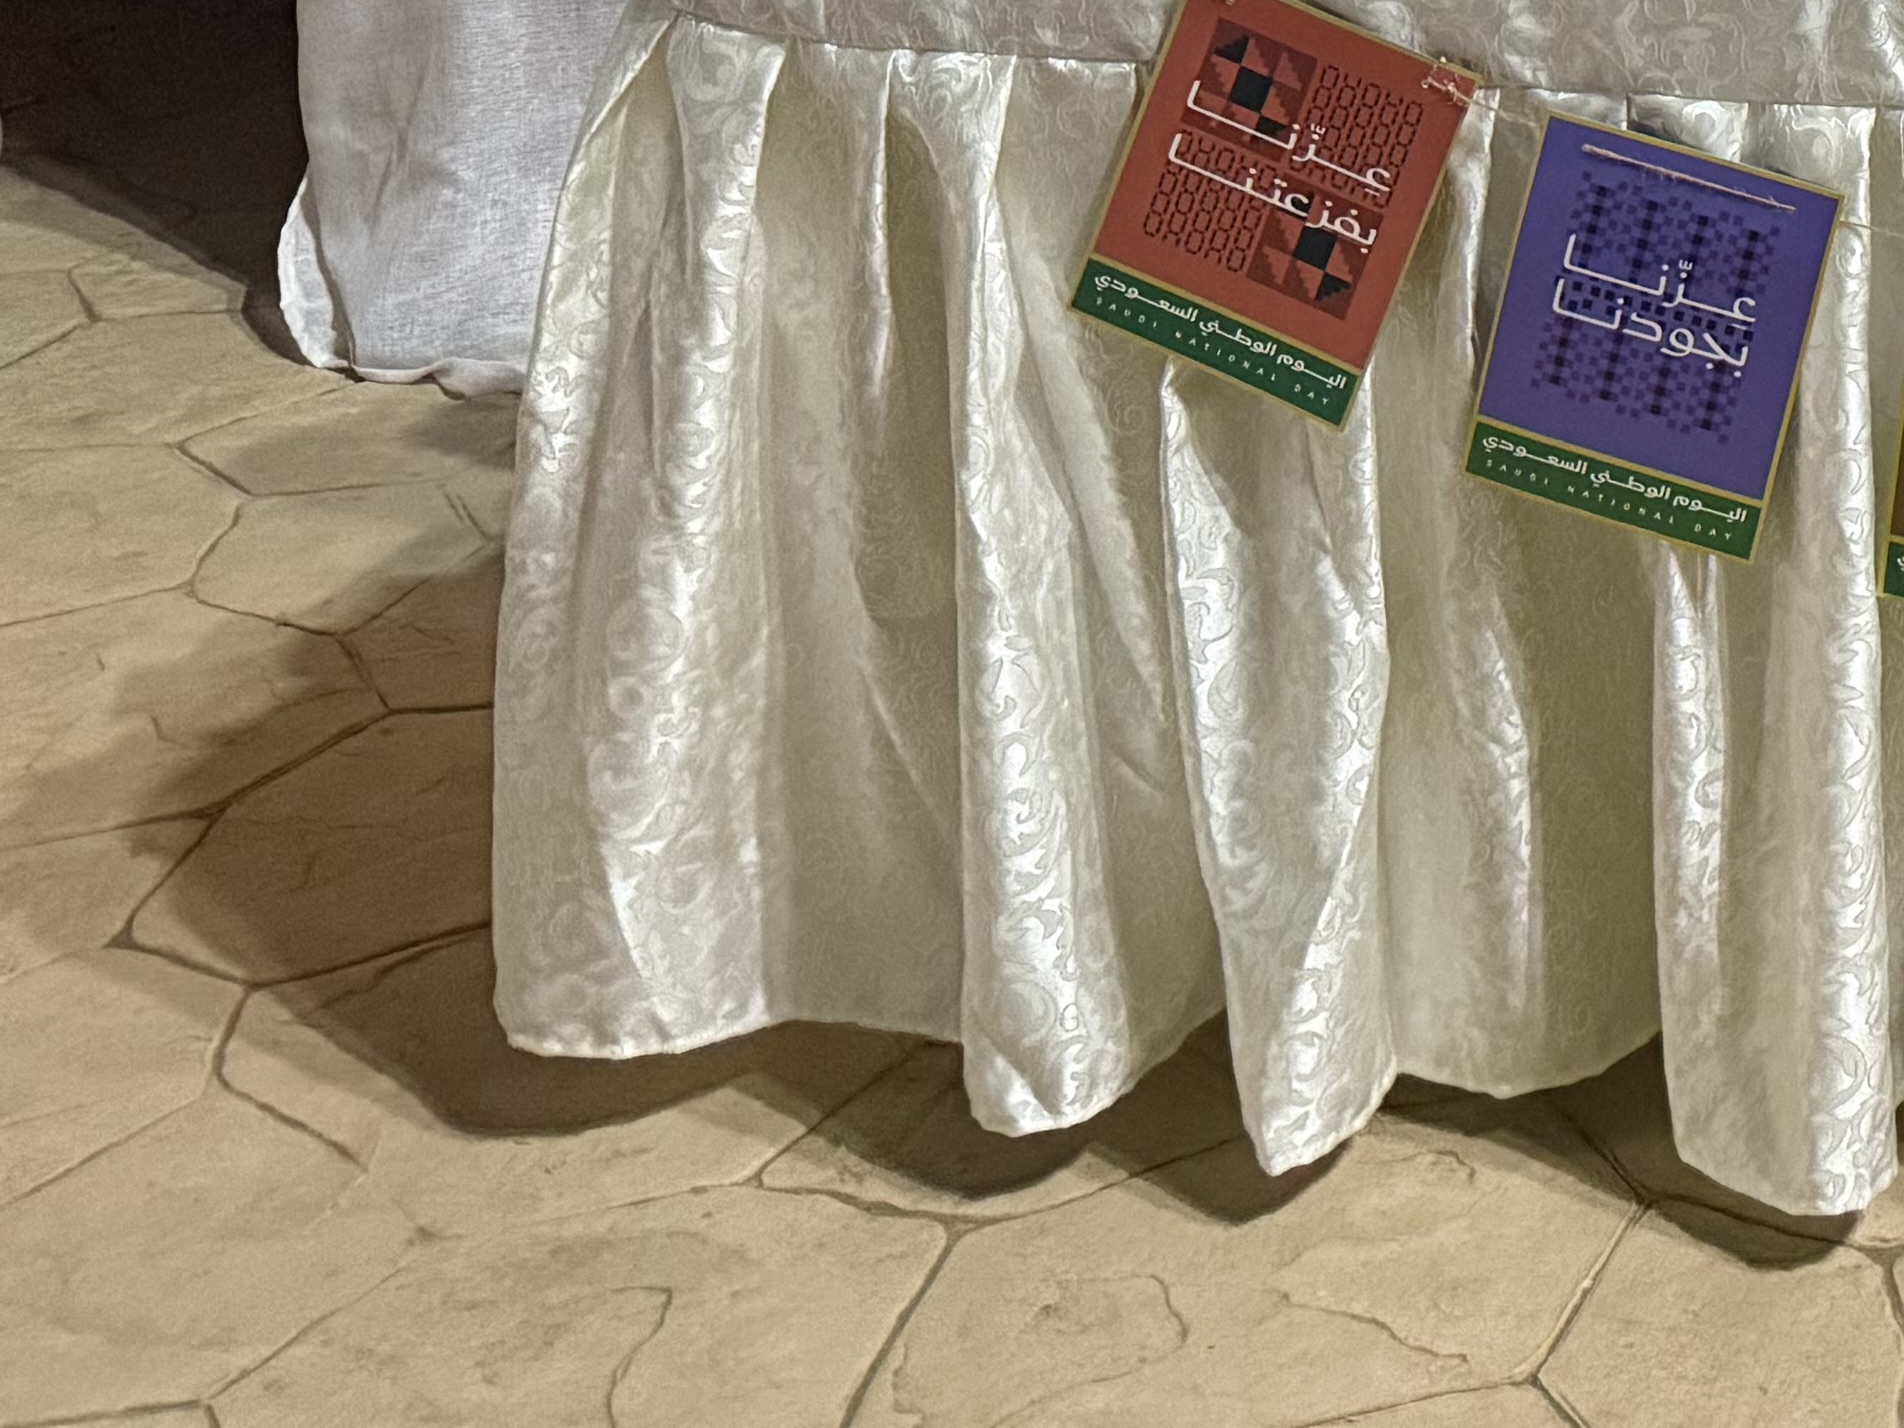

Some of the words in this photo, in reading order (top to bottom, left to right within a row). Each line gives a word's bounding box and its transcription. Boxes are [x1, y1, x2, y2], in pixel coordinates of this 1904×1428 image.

[1168, 133, 1377, 254] بفزعتنا
[1094, 274, 1199, 323] السعودي
[1199, 319, 1277, 358] الوطني
[1553, 278, 1749, 378] بجودنا
[1095, 298, 1157, 329] SAUDI
[1174, 330, 1277, 382] NATIONAL
[1293, 383, 1331, 405] DAY
[1276, 353, 1347, 390] اليوم
[1482, 436, 1589, 475] السعودي
[1486, 459, 1549, 485] SAUDI
[1567, 485, 1674, 525] NATIONAL
[1694, 523, 1733, 541] DAY
[1590, 471, 1671, 500] الوطني
[1673, 494, 1748, 523] اليوم
